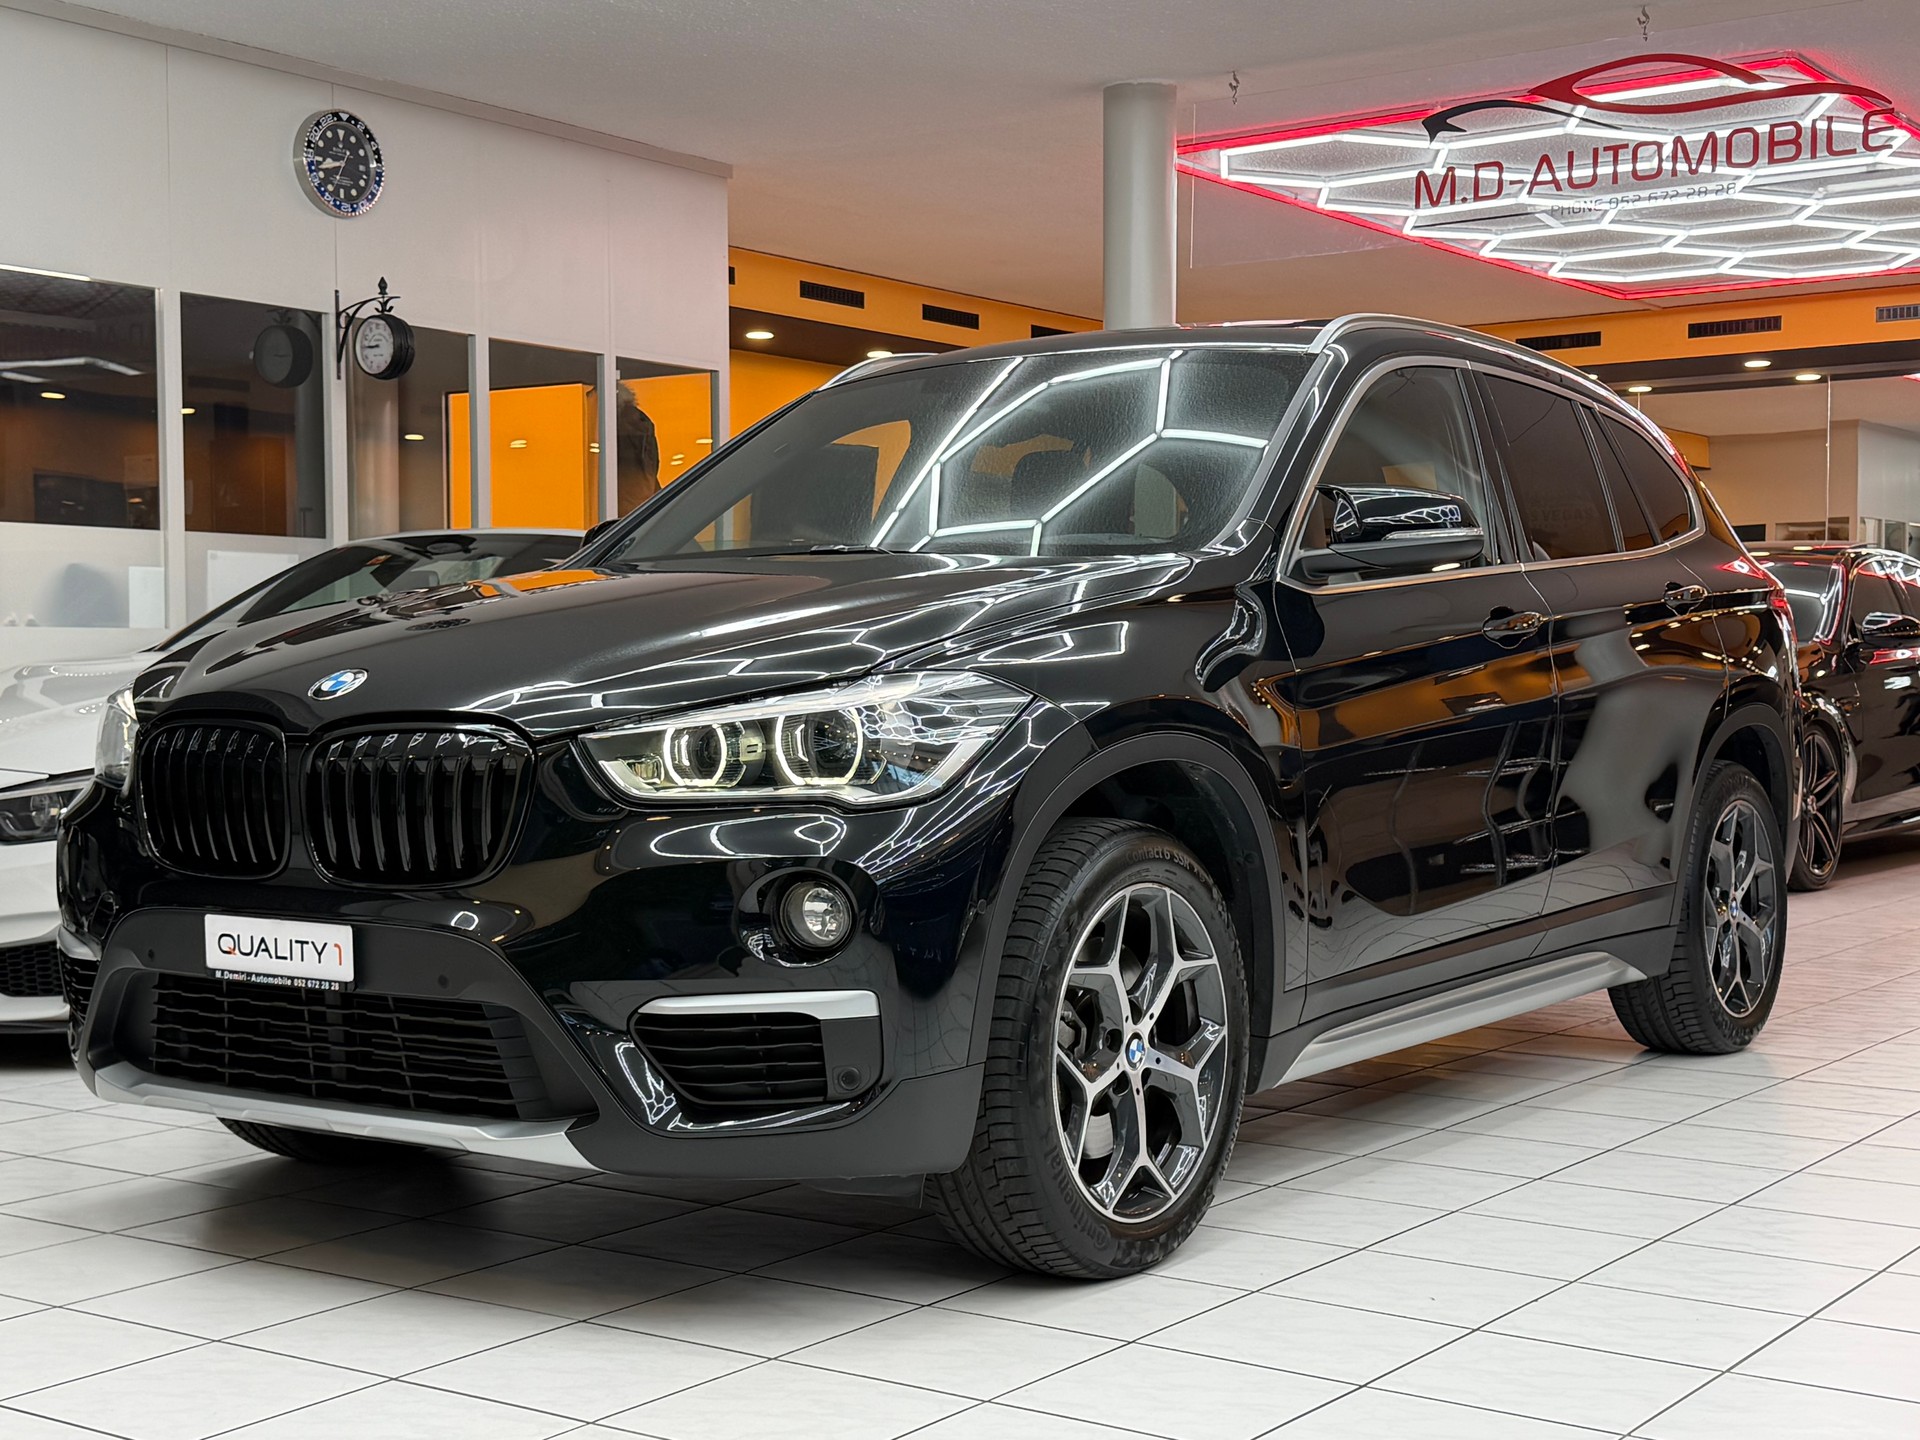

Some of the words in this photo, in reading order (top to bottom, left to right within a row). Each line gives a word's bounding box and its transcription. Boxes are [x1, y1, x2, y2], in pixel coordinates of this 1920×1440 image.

[1414, 106, 1896, 210] M.D-AUTOMOBILE
[217, 933, 328, 964] QUALITY
[333, 943, 343, 966] 1
